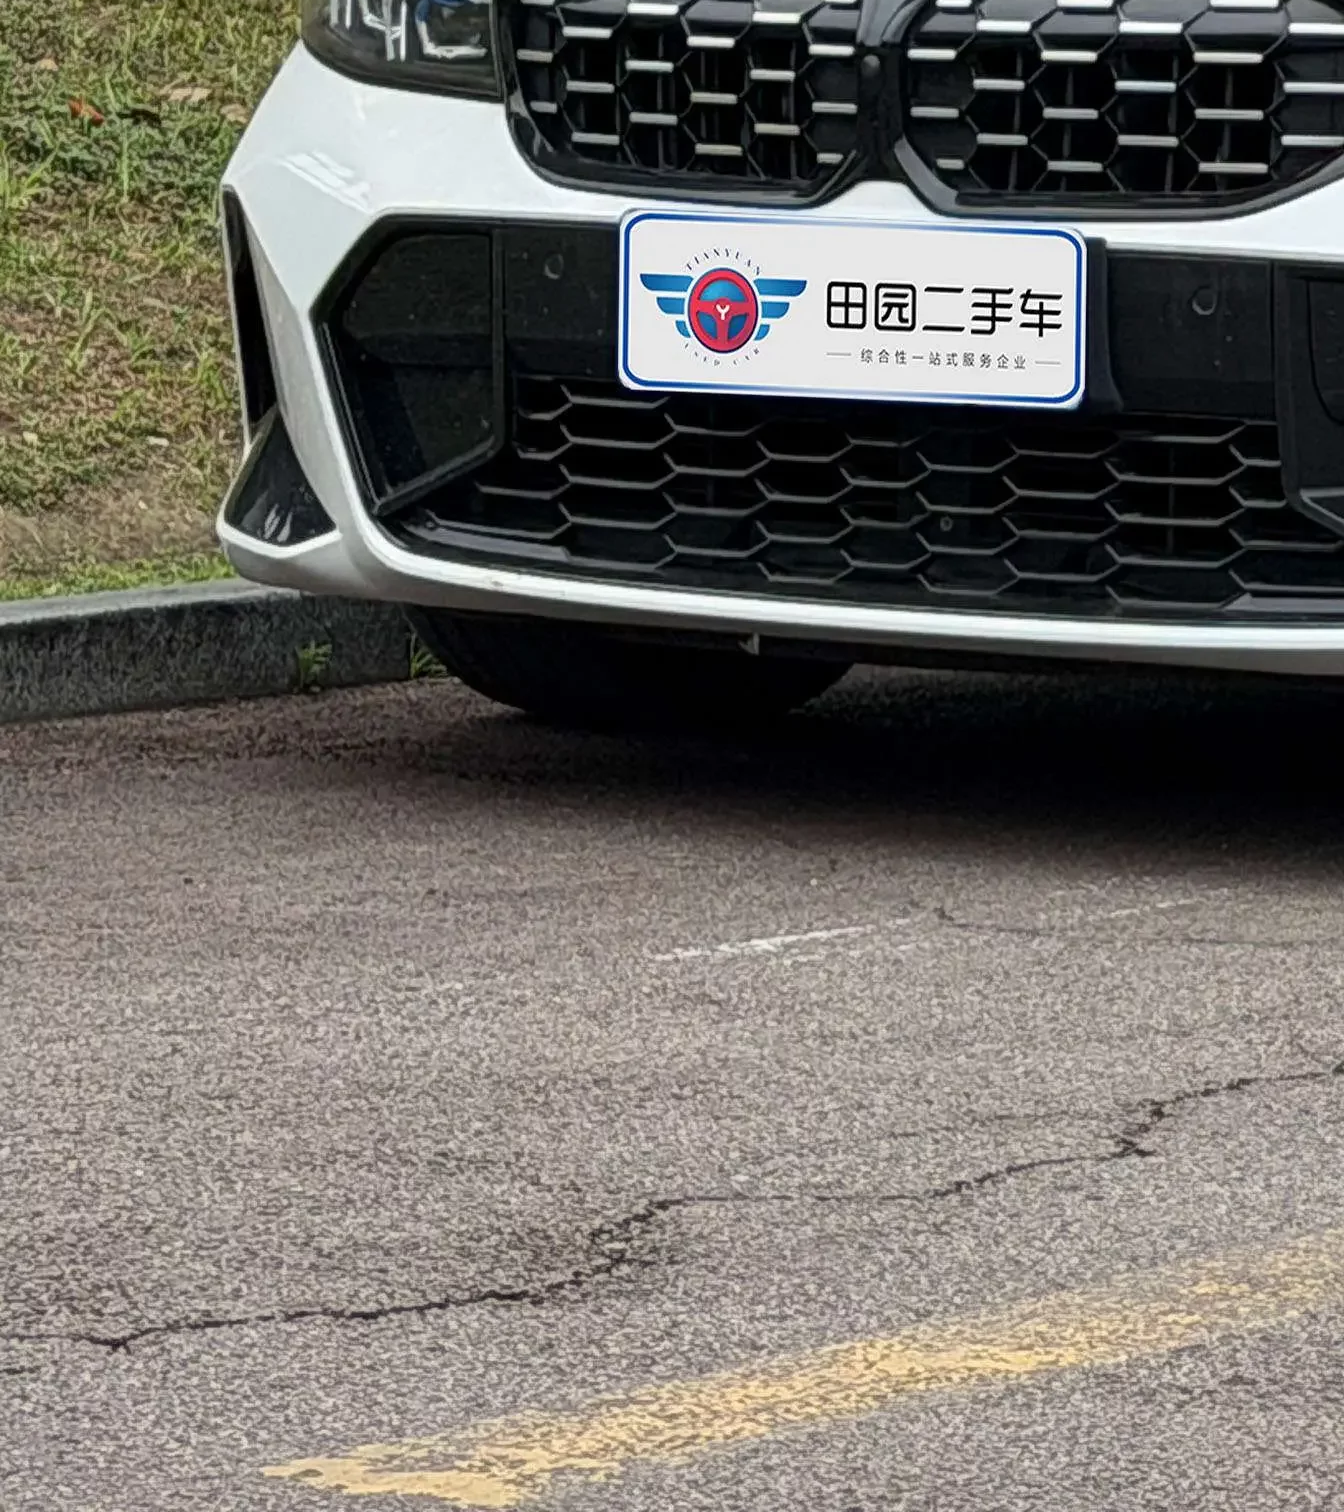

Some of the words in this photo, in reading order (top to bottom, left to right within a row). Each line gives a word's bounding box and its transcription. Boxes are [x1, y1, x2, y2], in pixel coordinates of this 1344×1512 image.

[826, 281, 1063, 338] 田园二手车
[860, 348, 1027, 370] 综合性一站式服务企业
